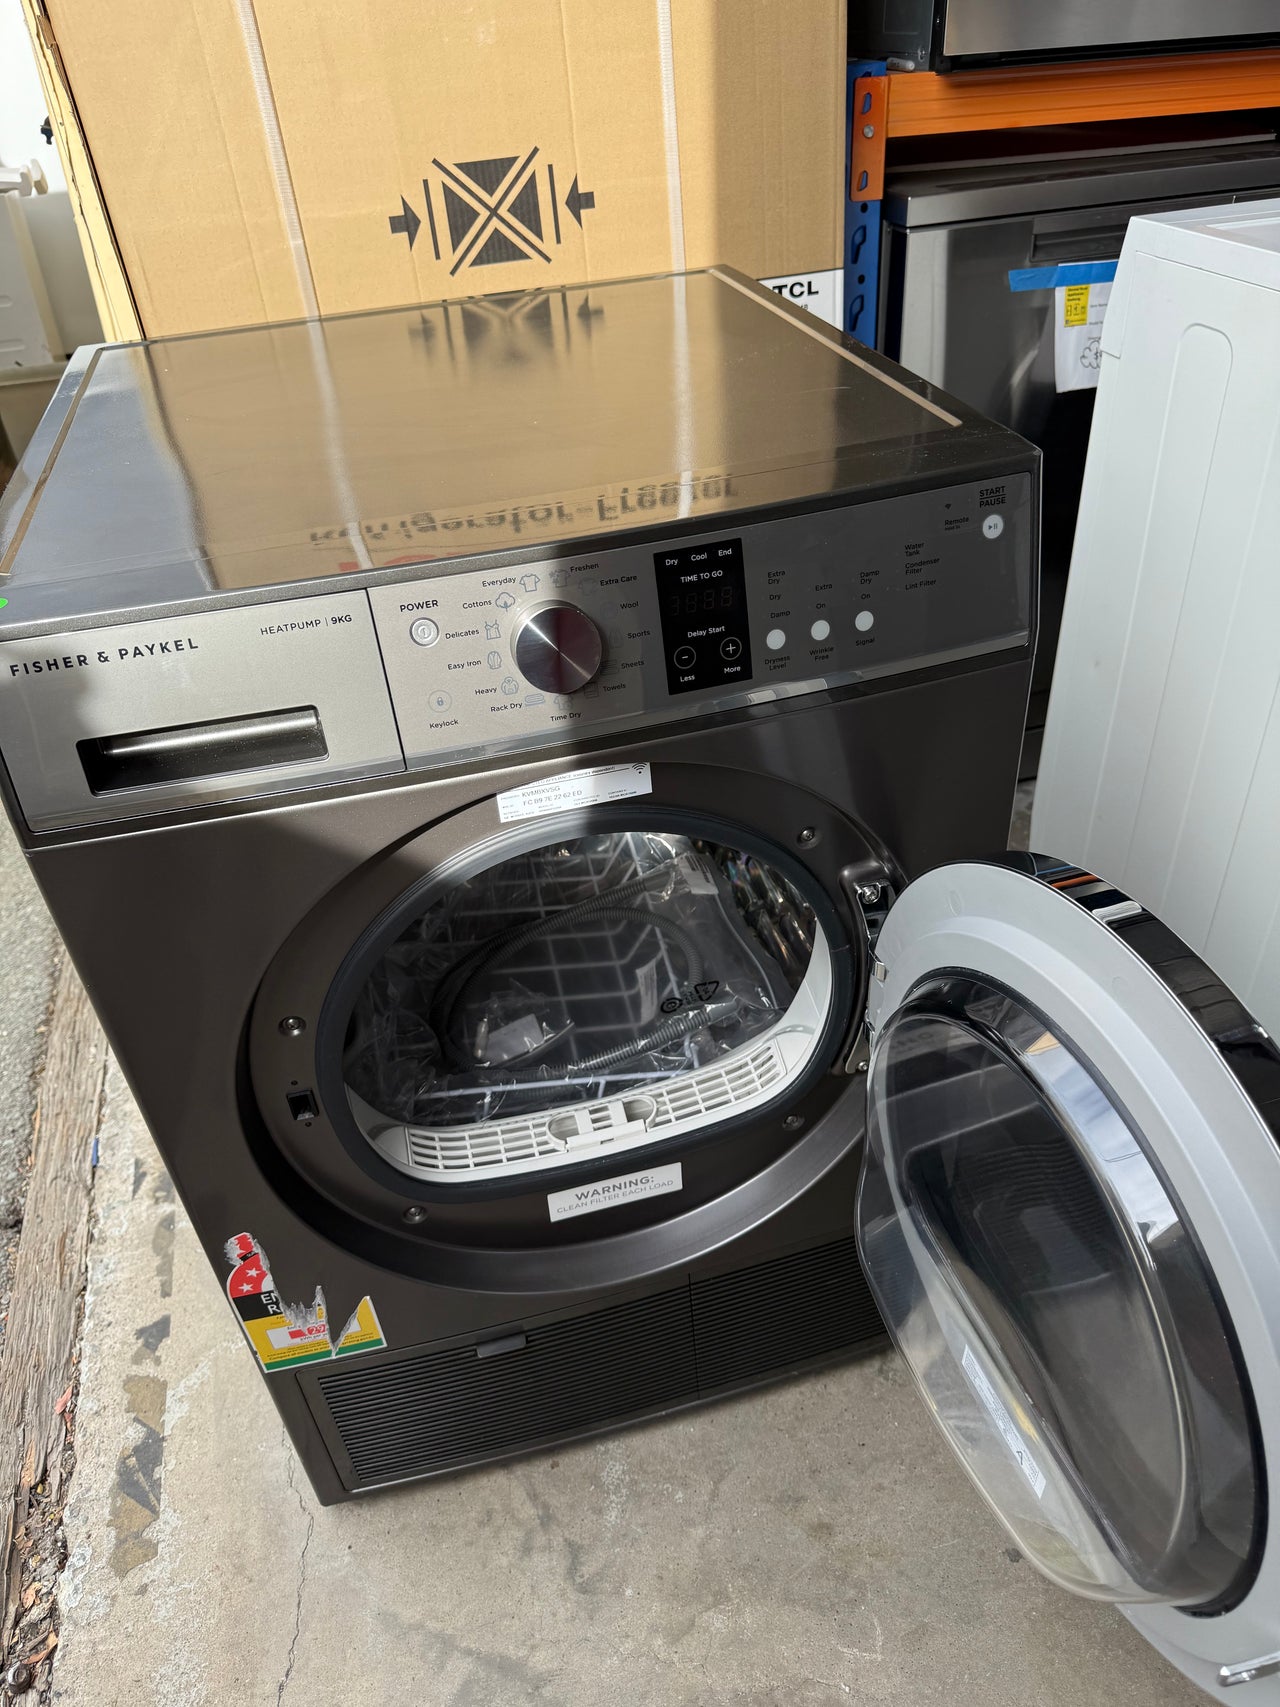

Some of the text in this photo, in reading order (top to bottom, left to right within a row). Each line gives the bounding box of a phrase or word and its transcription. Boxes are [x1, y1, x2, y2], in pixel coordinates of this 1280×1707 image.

[772, 281, 819, 298] TCL
[979, 486, 1006, 498] START
[979, 496, 1006, 509] PAUSE
[944, 516, 969, 526] Remote
[904, 541, 925, 551] Water
[691, 552, 708, 562] Cool
[718, 548, 732, 557] End
[904, 549, 921, 557] Tank
[569, 562, 599, 573] Freshen
[665, 558, 679, 567] Dry
[905, 557, 940, 569] Condenser
[767, 570, 786, 579] Extra
[860, 569, 880, 579] Damp
[905, 566, 923, 575] Filter
[481, 576, 517, 588] Everyday
[600, 574, 637, 586] Extra Care
[680, 570, 723, 584] TIME TO GO
[768, 577, 780, 585] Dry
[860, 576, 872, 585] Dry
[815, 582, 833, 592] Extra
[905, 578, 937, 591] Lint Filter
[769, 593, 781, 601] Dry
[861, 592, 871, 600] On
[399, 599, 439, 613] POWER
[462, 598, 492, 610] Cottons
[619, 601, 639, 610] Wool
[816, 602, 826, 610] On
[770, 610, 791, 619] Damp
[260, 614, 353, 636] HEATPUMP 9KG
[445, 628, 480, 640] Delicates
[627, 630, 650, 641] Sports
[687, 625, 726, 639] Delay Start
[855, 636, 875, 647] Signal
[809, 645, 835, 657] Wrinkle
[9, 637, 200, 678] FISHER & PAYKEL
[764, 655, 790, 666] Dryness
[814, 653, 830, 662] Free
[447, 658, 482, 671] Easy Iron
[621, 659, 645, 670] Sheets
[724, 665, 741, 674] More
[769, 662, 787, 671] Level
[680, 674, 695, 682] Less
[475, 685, 497, 696] Heavy
[602, 682, 626, 693] Towels
[490, 701, 523, 713] Rack Dry
[550, 711, 582, 722] Time Dry
[429, 718, 459, 730] Keylock
[575, 1175, 655, 1201] WARNING:
[556, 1179, 674, 1213] CLEAN FILTER EACH LOAD
